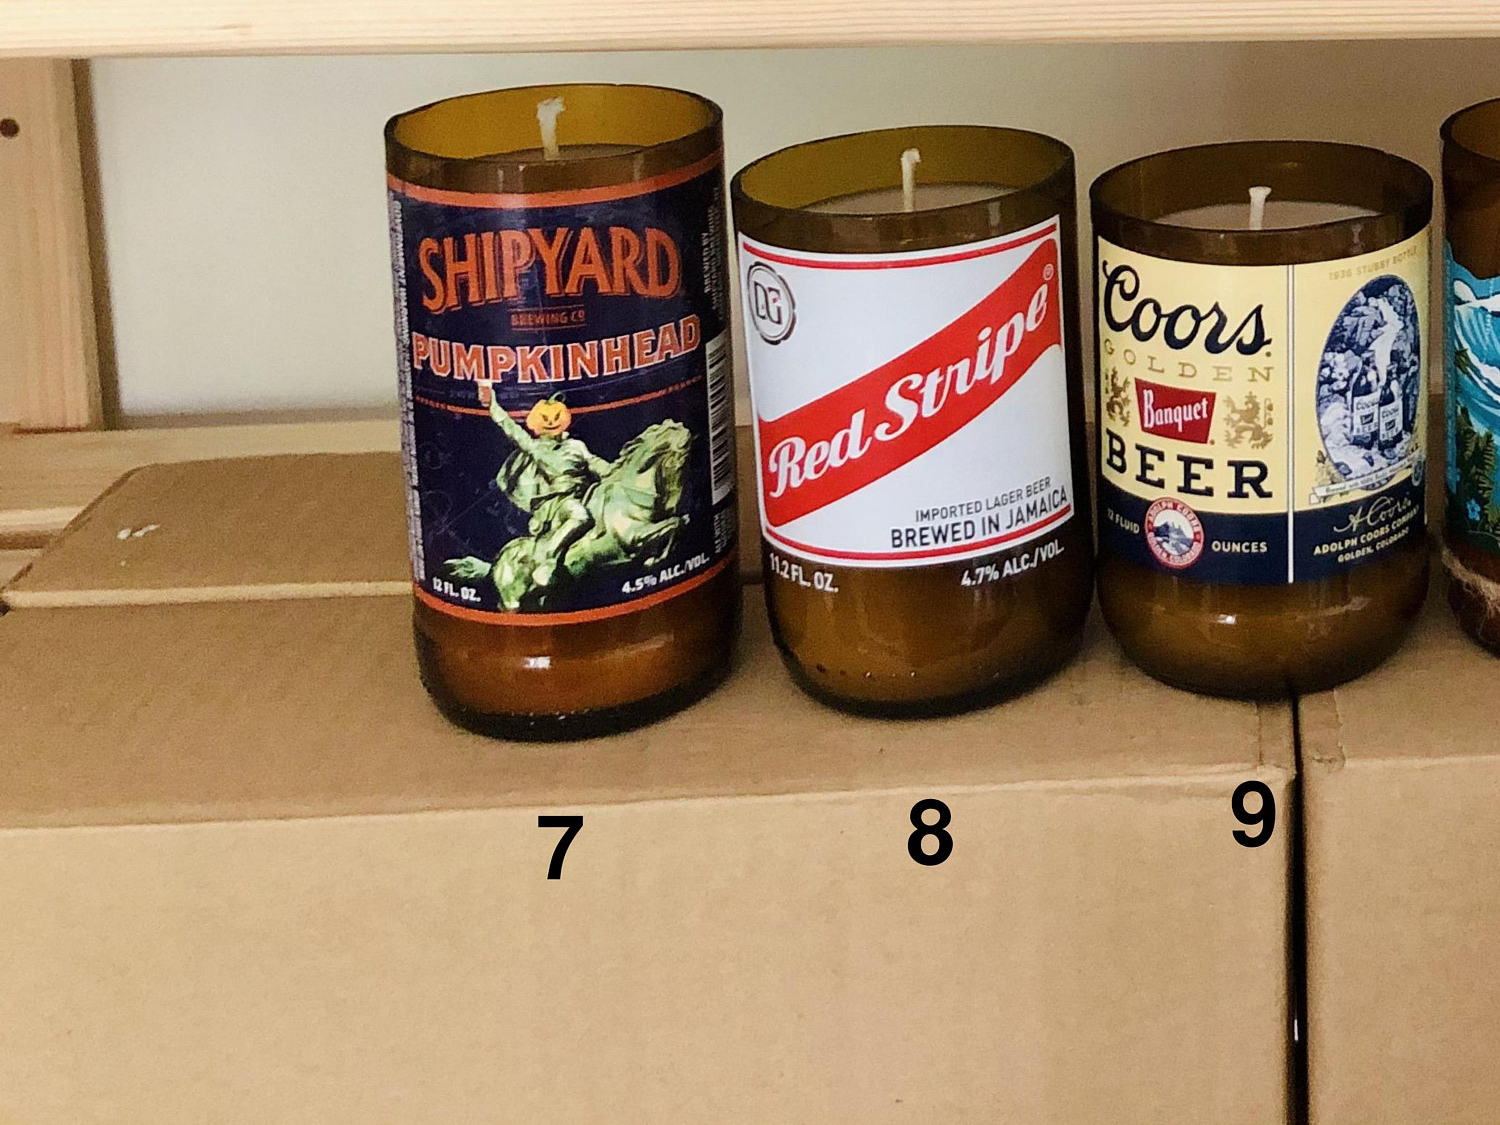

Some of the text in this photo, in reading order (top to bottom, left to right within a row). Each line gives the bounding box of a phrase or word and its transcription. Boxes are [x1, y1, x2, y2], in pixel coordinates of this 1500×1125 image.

[418, 225, 684, 314] SHIPYARD
[1356, 258, 1390, 276] STUBBY
[510, 312, 566, 326] BREWING
[1102, 259, 1272, 356] Coors
[411, 313, 701, 383] PUMPKINHEAD
[1102, 337, 1275, 383] GOLDEN
[769, 283, 1048, 498] Red Stripe
[1143, 388, 1210, 433] Banquet
[1105, 427, 1273, 500] BEER
[891, 484, 1068, 549] BREWED IN JAMAICA
[915, 476, 1052, 522] IMPORTED LAGER BEER
[1115, 513, 1140, 535] FLUID
[1313, 524, 1391, 556] ADOLPH COORS
[1211, 540, 1268, 553] OUNCES
[459, 586, 481, 602] OZ.
[622, 575, 657, 594] 4.5%
[770, 552, 839, 593] 11.2 FL. OZ.
[961, 565, 1000, 588] 4.7%
